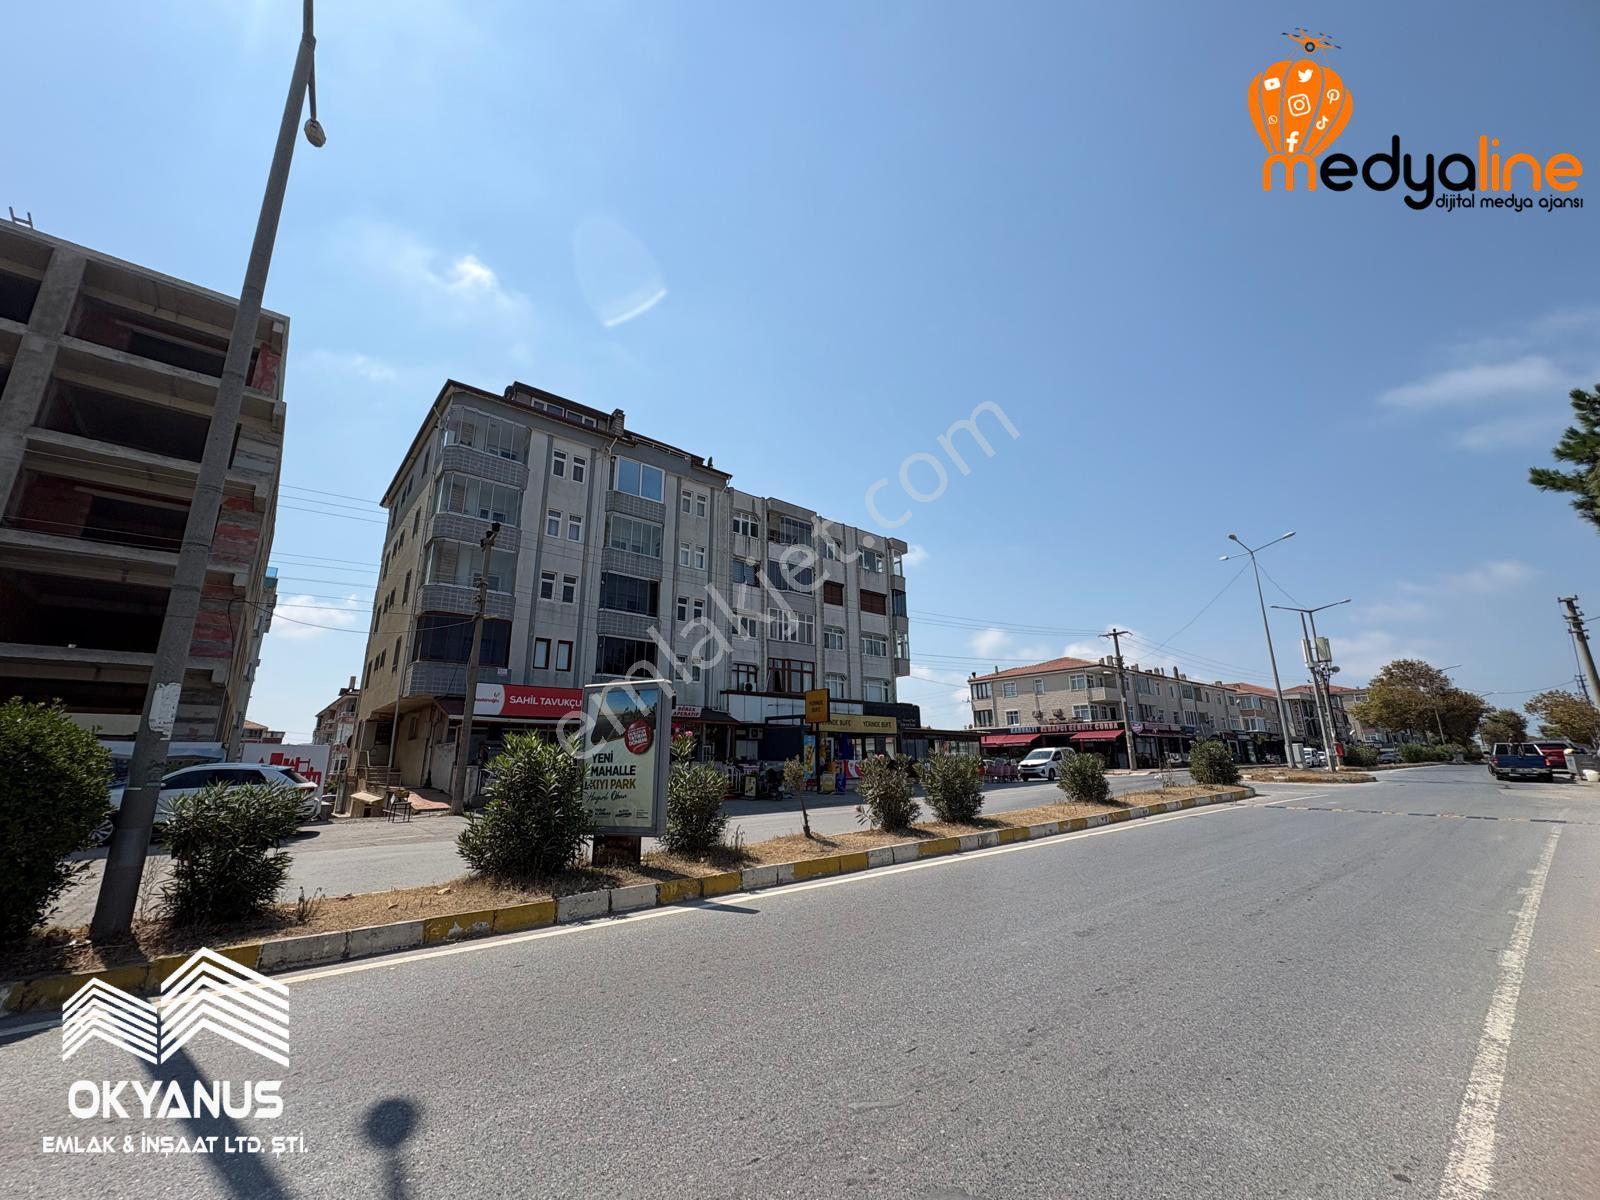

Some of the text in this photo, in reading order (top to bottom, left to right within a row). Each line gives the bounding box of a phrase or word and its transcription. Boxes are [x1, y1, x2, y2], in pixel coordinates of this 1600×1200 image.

[509, 694, 538, 705] SAHİL
[540, 697, 582, 709] TAVUKÇU
[592, 750, 613, 763] YENİ
[590, 765, 636, 776] MAHALLE
[610, 778, 636, 789] PARK
